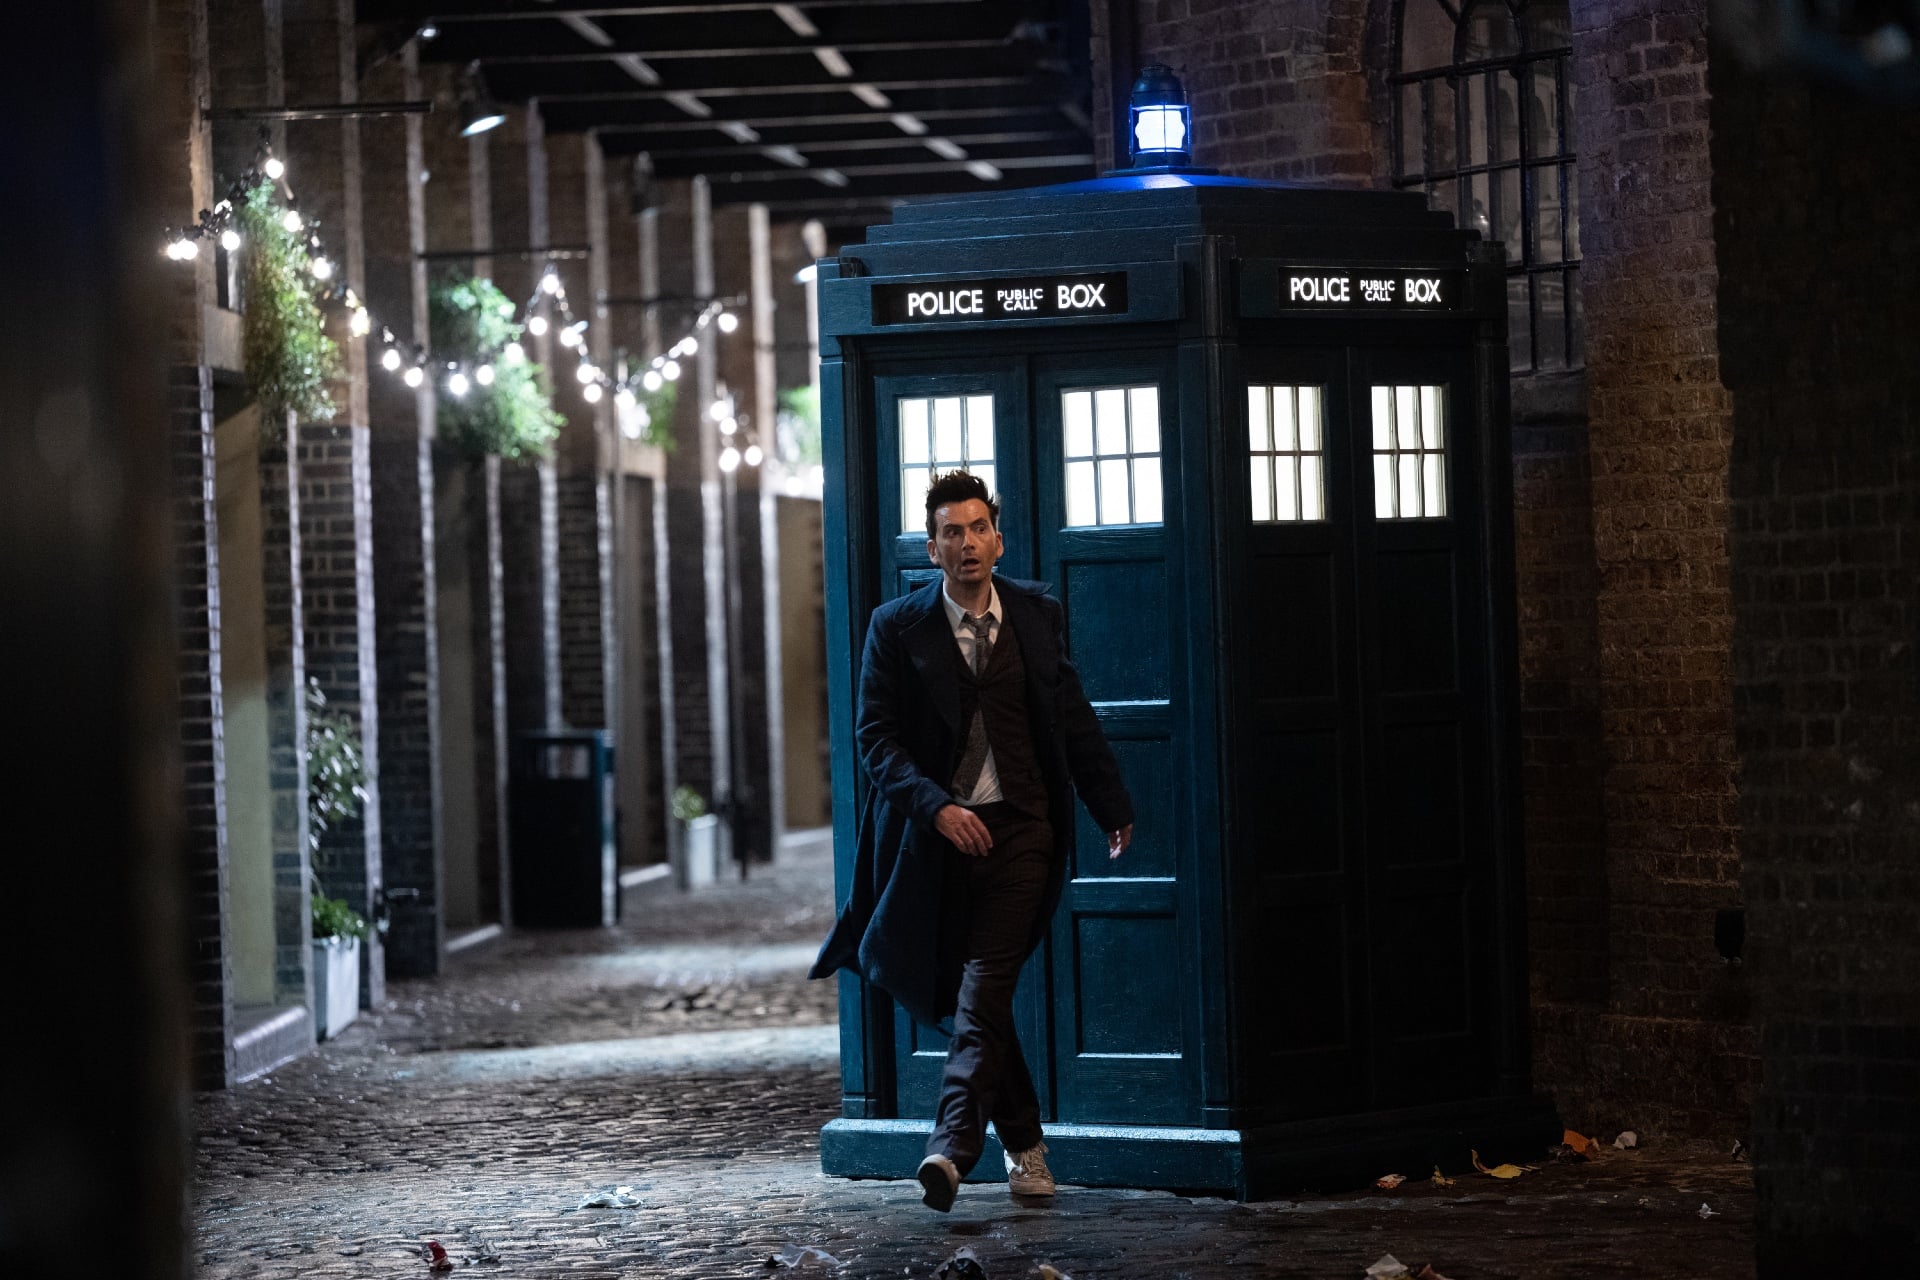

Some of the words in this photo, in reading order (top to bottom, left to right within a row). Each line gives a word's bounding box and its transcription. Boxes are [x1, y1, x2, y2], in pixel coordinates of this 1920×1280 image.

[997, 288, 1043, 301] PUBLIC
[1290, 277, 1350, 302] POLICE
[1360, 280, 1395, 291] PUBLIC
[1405, 279, 1441, 303] BOX
[908, 290, 984, 317] POLICE
[1003, 299, 1038, 311] CALL
[1057, 284, 1105, 309] BOX
[1364, 290, 1391, 302] CALL
